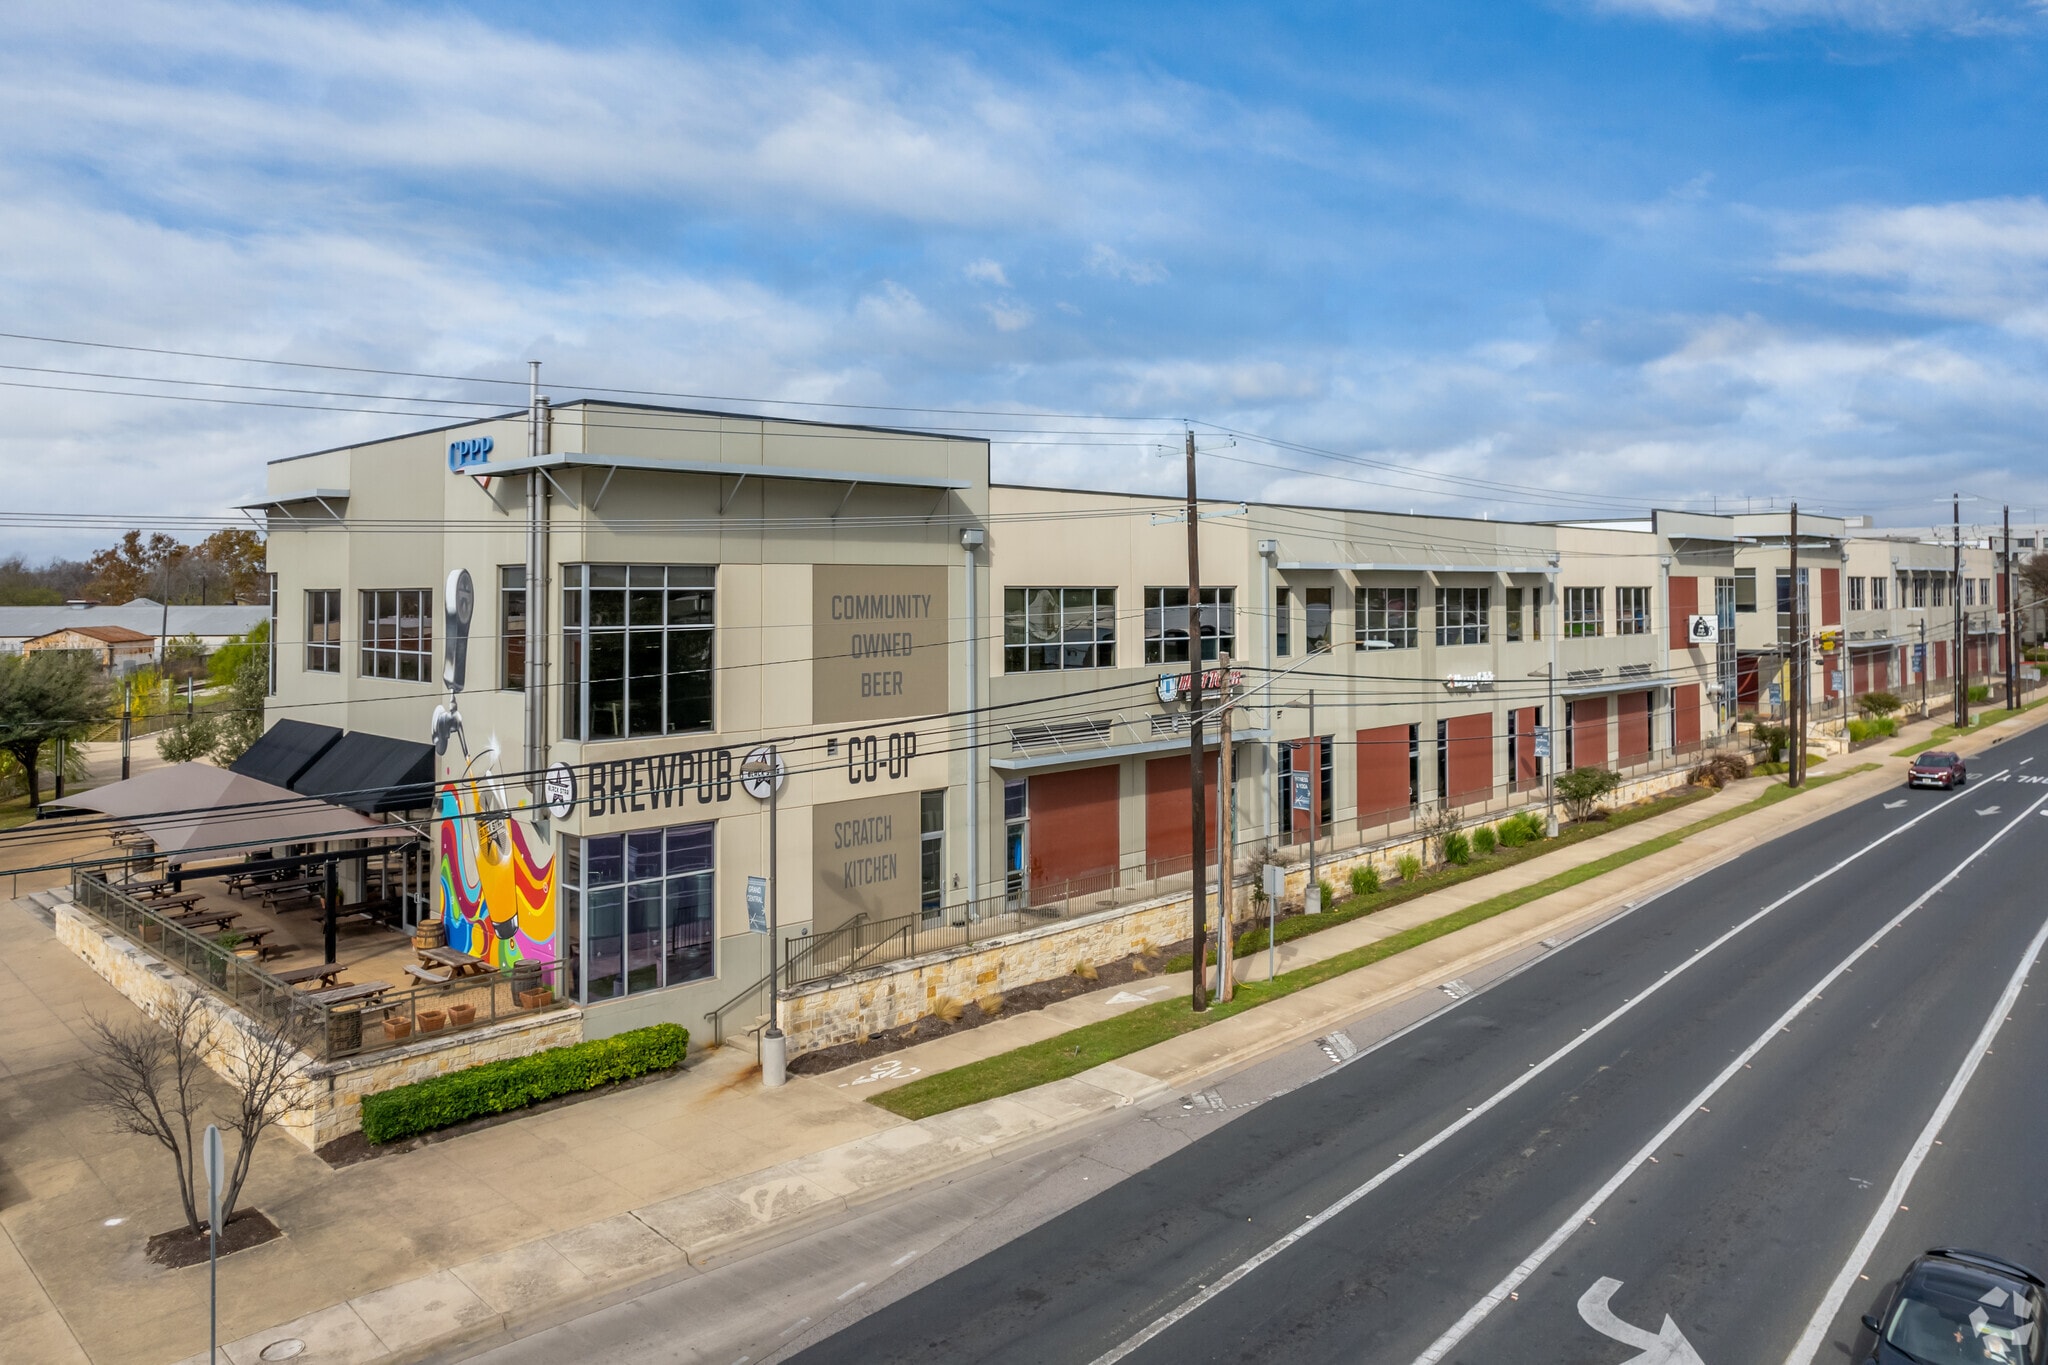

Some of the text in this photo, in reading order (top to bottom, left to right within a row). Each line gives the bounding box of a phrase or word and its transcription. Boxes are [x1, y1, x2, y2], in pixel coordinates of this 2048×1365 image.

[832, 594, 931, 620] COMMUNITY
[851, 632, 912, 659] OWNED
[861, 670, 904, 698] BEER
[848, 731, 917, 784] CO-OP
[587, 748, 732, 817] BREWPUB
[834, 815, 893, 849] SCRATCH
[843, 853, 898, 888] KITCHEN
